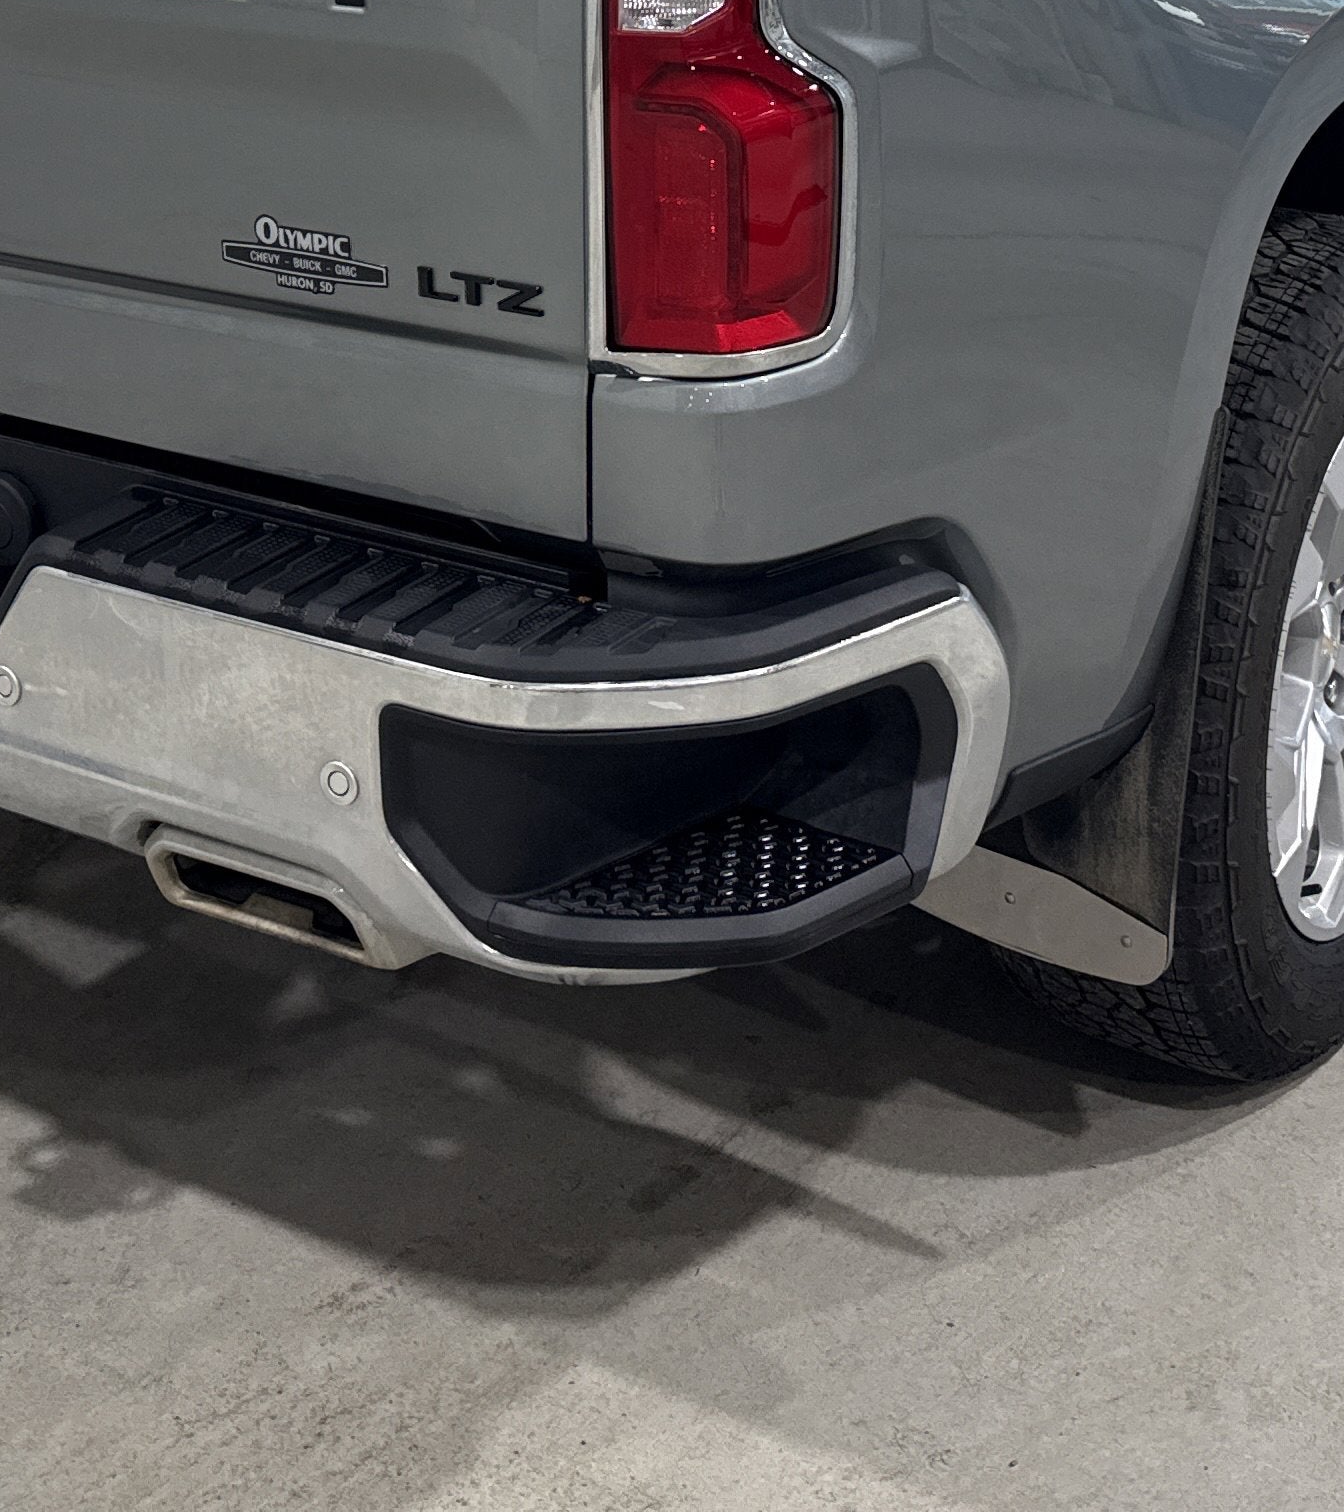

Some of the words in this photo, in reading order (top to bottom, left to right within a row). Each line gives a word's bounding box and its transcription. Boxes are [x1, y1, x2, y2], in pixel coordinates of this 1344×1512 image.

[250, 249, 280, 265] CHEVY
[293, 256, 321, 273] BUICK
[335, 264, 357, 279] GMC
[277, 273, 318, 292] HURON,
[319, 279, 334, 293] SD
[417, 265, 544, 317] LTZ
